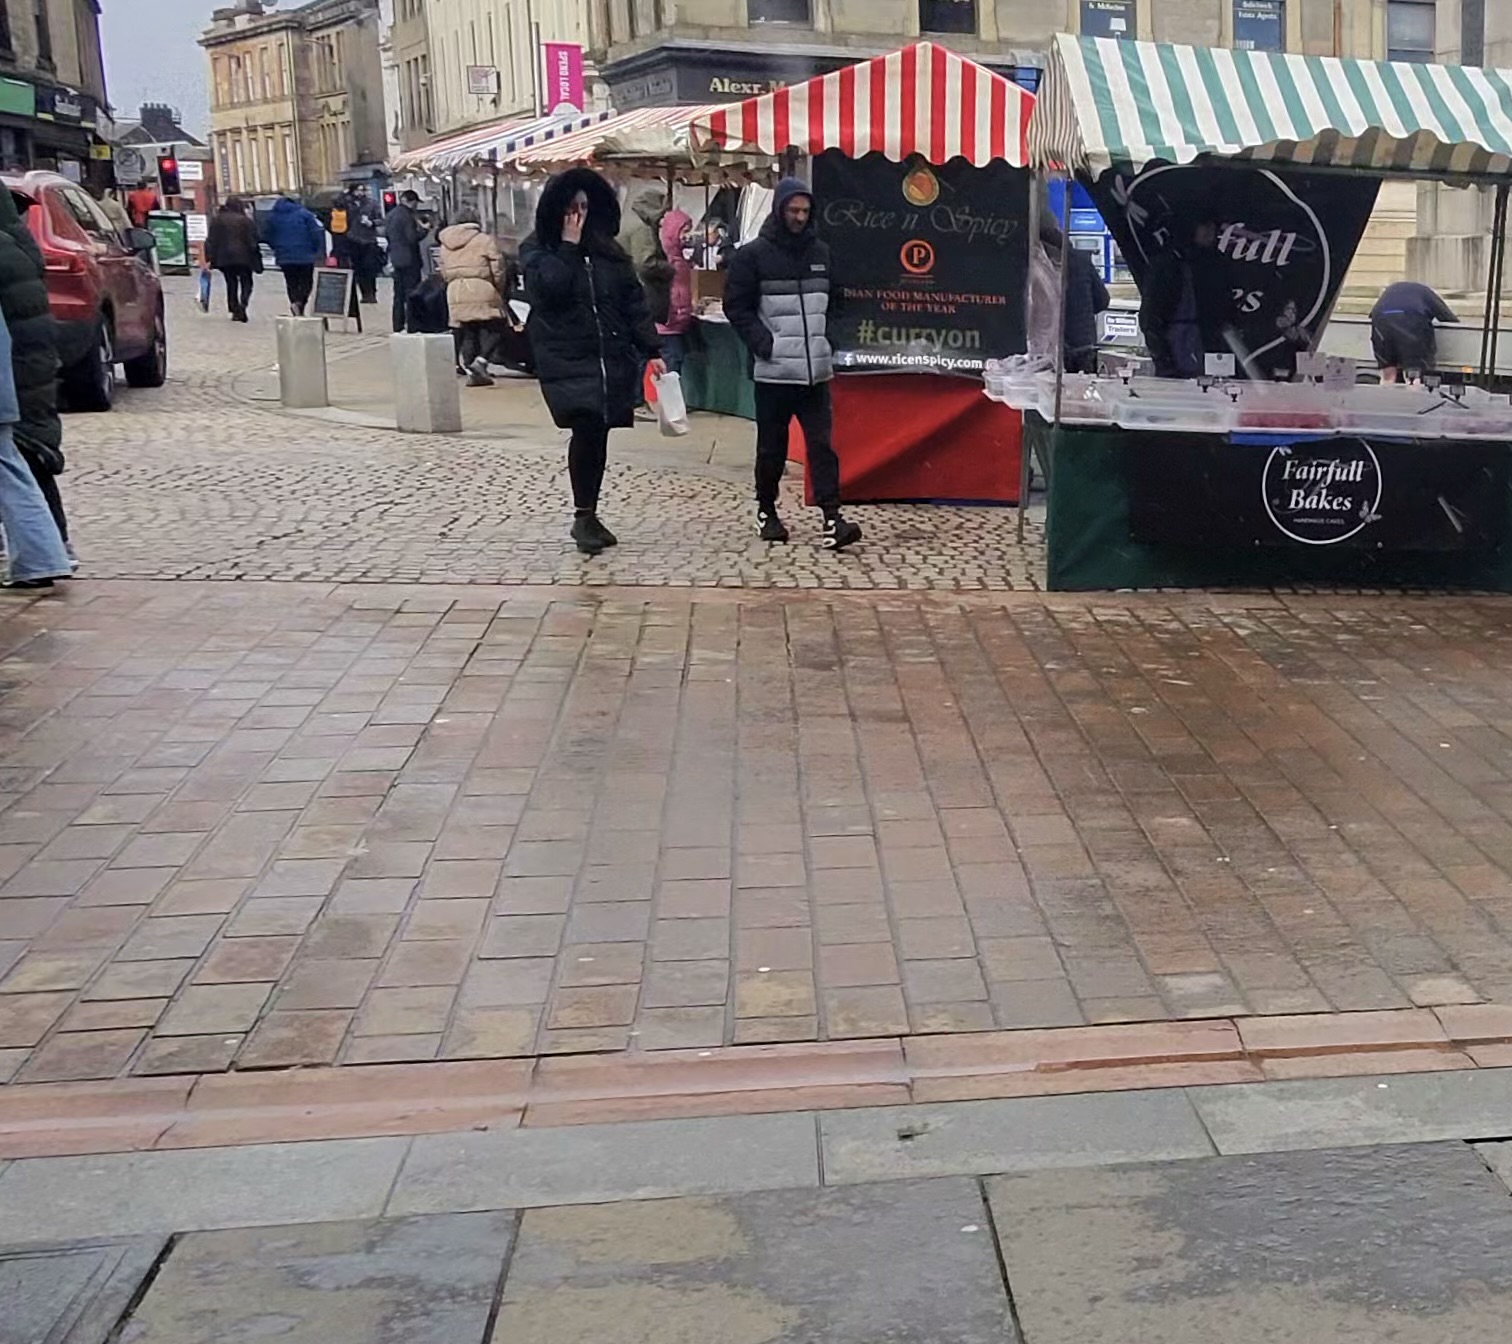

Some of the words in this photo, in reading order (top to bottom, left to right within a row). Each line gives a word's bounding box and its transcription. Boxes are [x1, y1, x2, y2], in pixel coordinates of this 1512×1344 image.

[558, 50, 570, 76] SPEND
[559, 76, 571, 101] LOCAL
[709, 77, 766, 94] Alexr.
[823, 198, 896, 230] Rice
[901, 212, 919, 231] n
[930, 205, 1018, 244] Spicy
[876, 289, 910, 301] FOOD
[913, 291, 1007, 306] MANUFACTURER
[881, 302, 895, 312] OF
[902, 302, 924, 313] THE
[926, 303, 957, 314] YEAR
[857, 318, 981, 353] #curryon
[1281, 458, 1365, 488] Fairfull
[1288, 488, 1353, 511] Bakes
